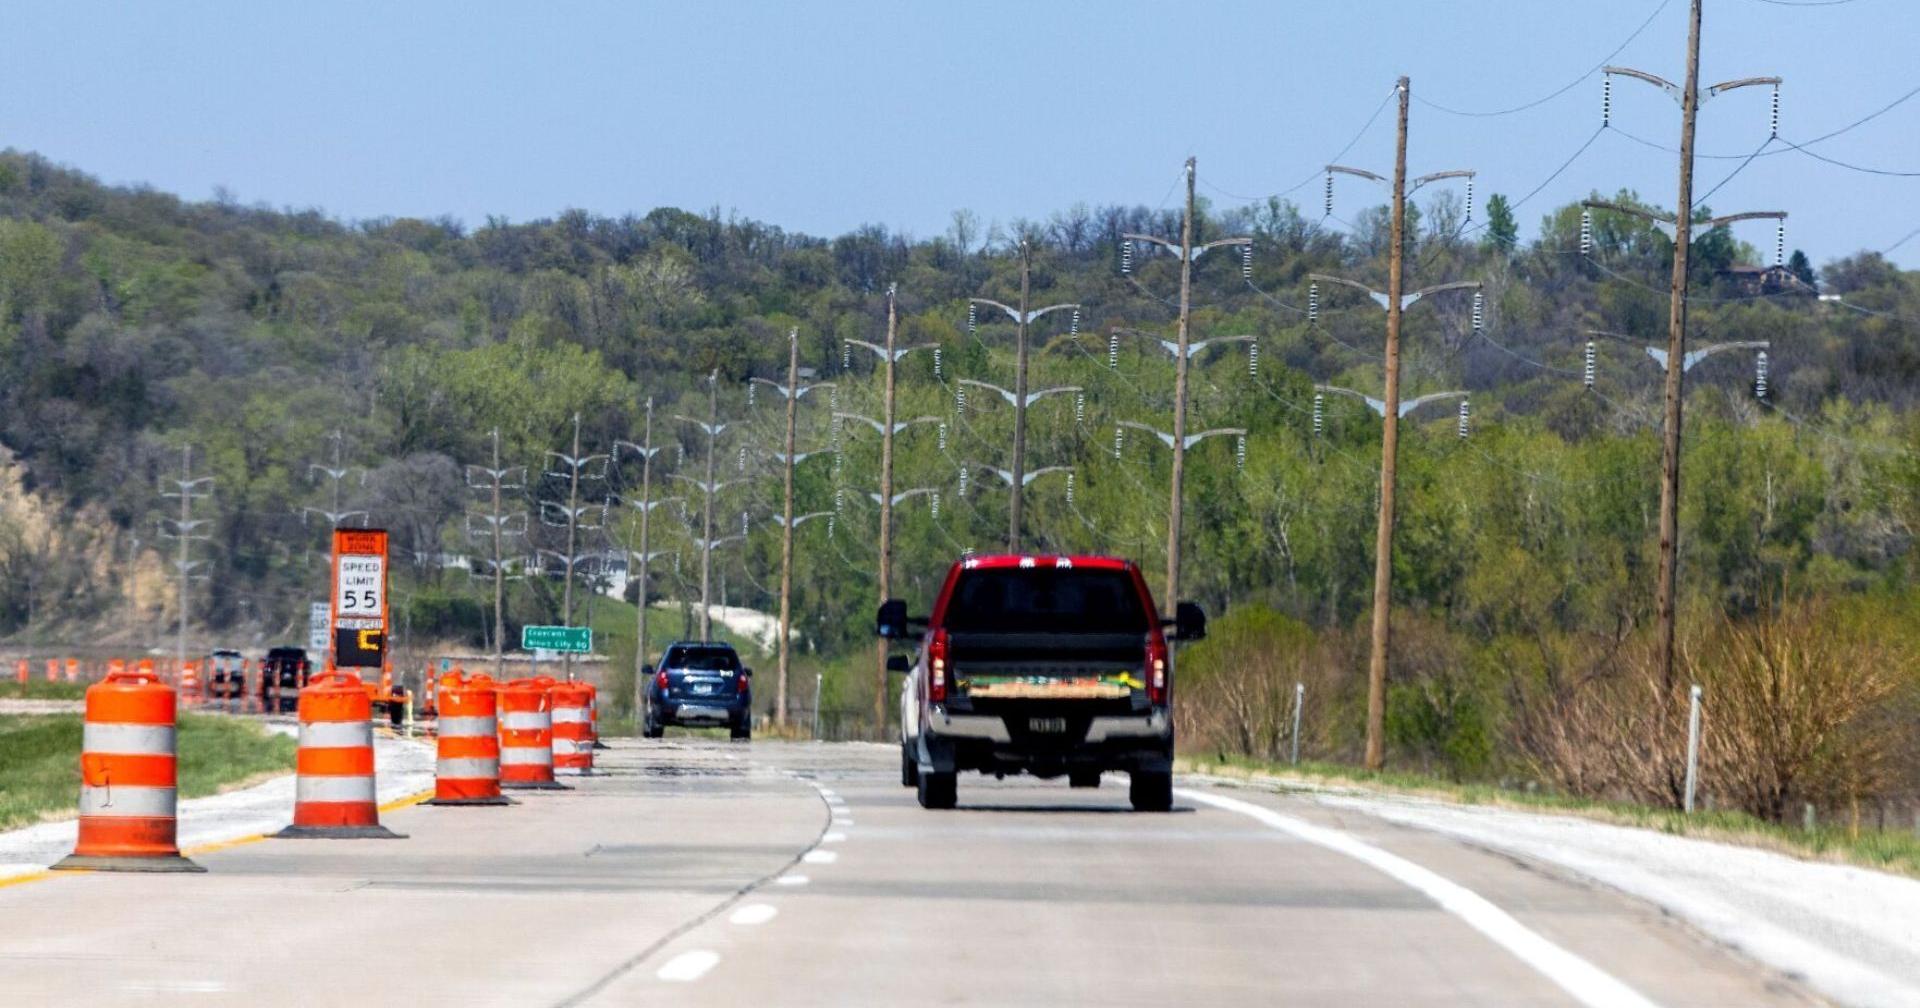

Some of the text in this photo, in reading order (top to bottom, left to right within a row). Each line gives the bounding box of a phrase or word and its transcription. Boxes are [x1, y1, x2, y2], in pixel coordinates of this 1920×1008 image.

[343, 562, 379, 572] SPEED
[346, 576, 375, 585] LIMIT
[344, 590, 376, 609] 55
